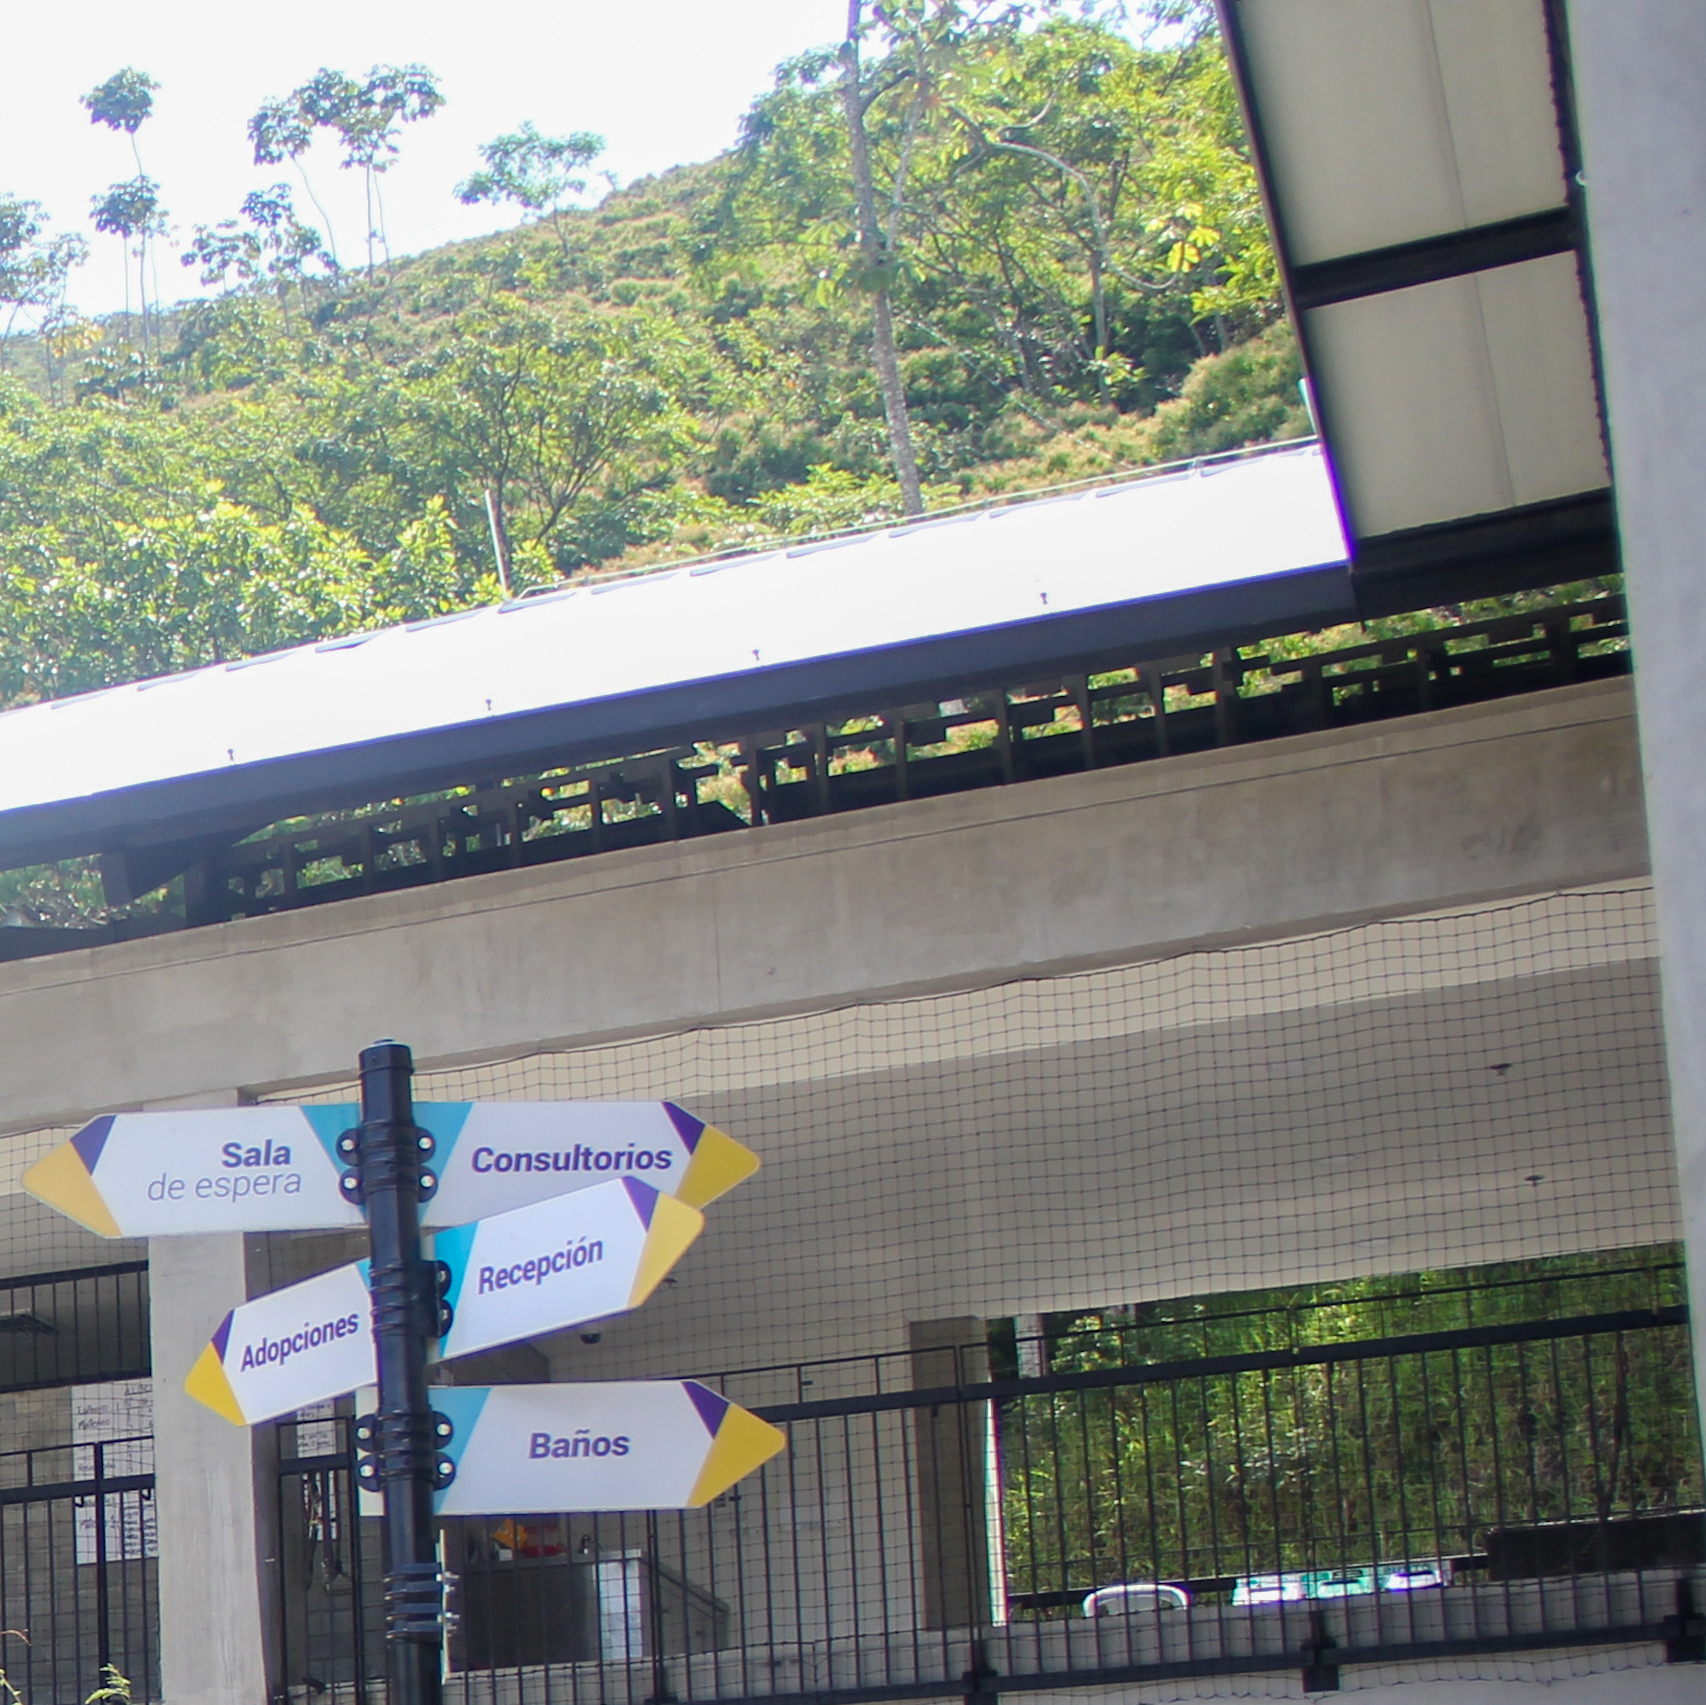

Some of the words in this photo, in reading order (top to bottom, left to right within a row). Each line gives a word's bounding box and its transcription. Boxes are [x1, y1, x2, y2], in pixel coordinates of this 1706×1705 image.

[221, 1138, 291, 1168] Sala
[471, 1143, 673, 1173] Consultorios
[147, 1172, 186, 1201] de
[195, 1173, 302, 1203] espera
[478, 1236, 603, 1295] Recepción
[240, 1313, 359, 1372] Adopciones
[528, 1428, 630, 1459] Baños
